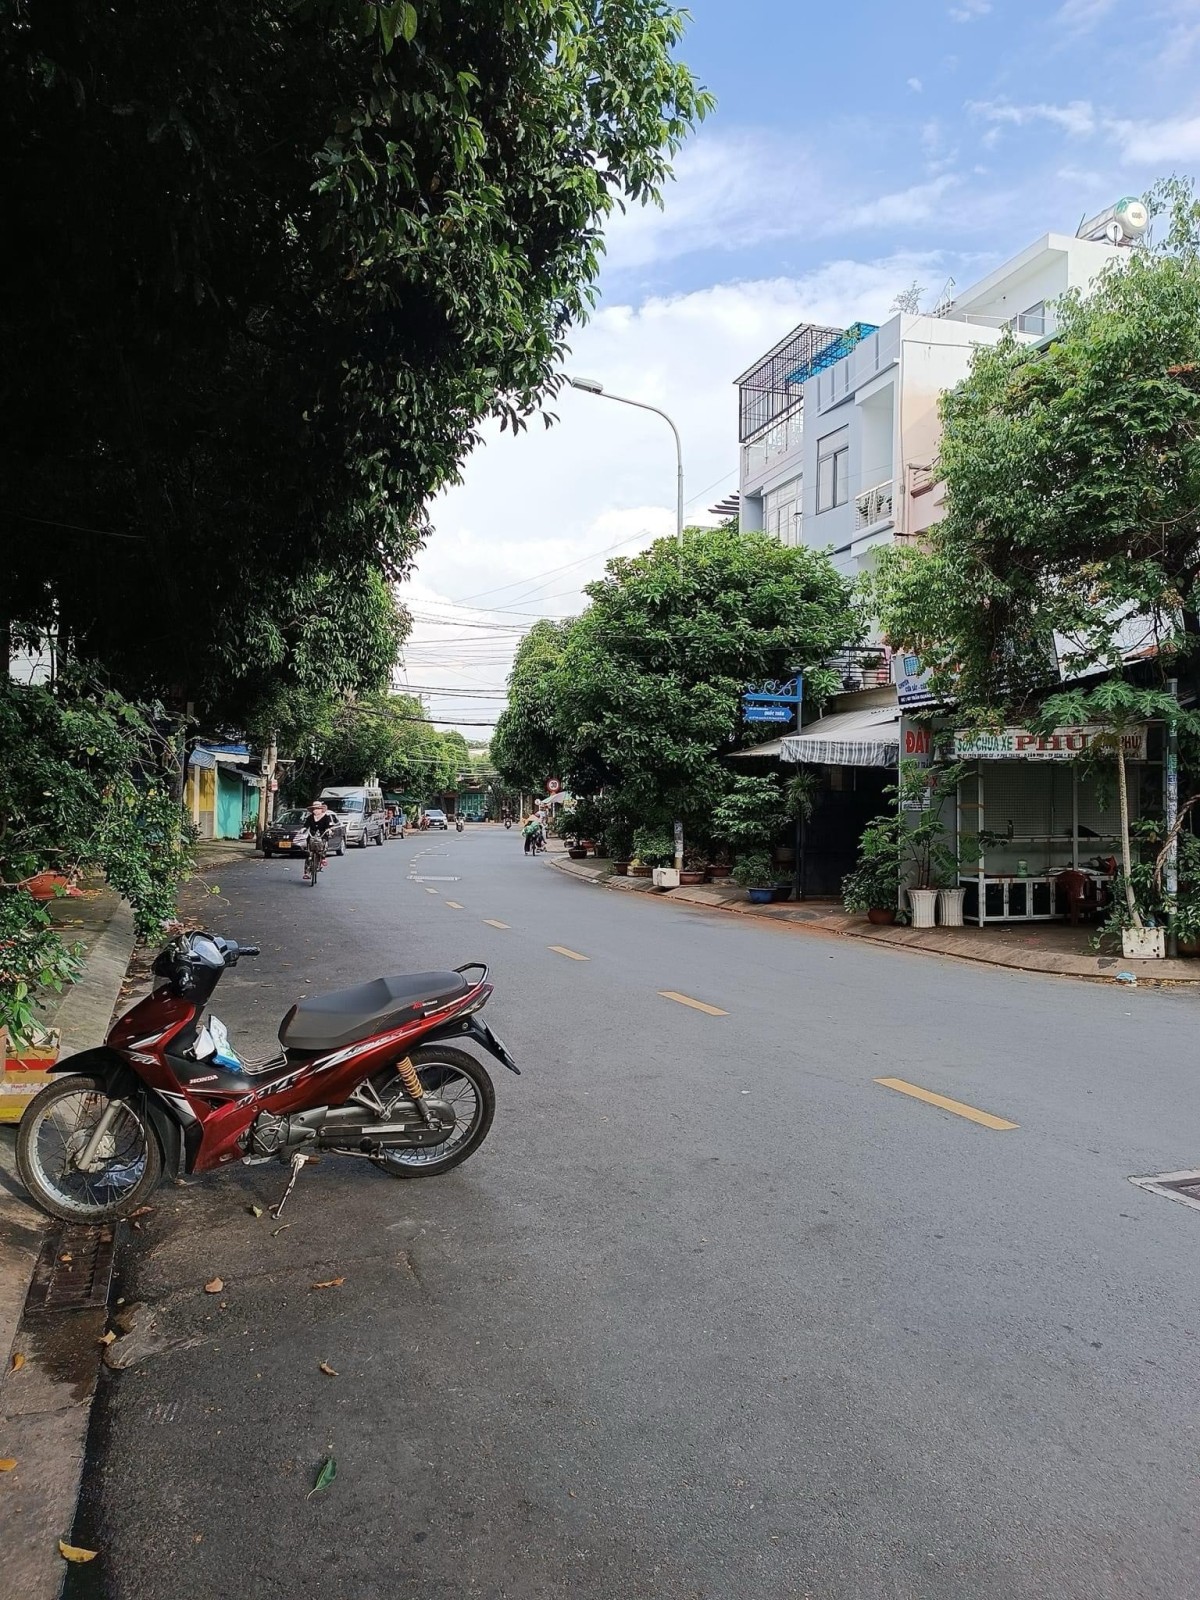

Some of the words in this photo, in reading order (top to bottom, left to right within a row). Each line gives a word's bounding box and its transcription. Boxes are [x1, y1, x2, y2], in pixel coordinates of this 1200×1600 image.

[1001, 736, 1014, 752] XE
[1015, 728, 1091, 751] PHÚ
[188, 1074, 220, 1084] HONDA
